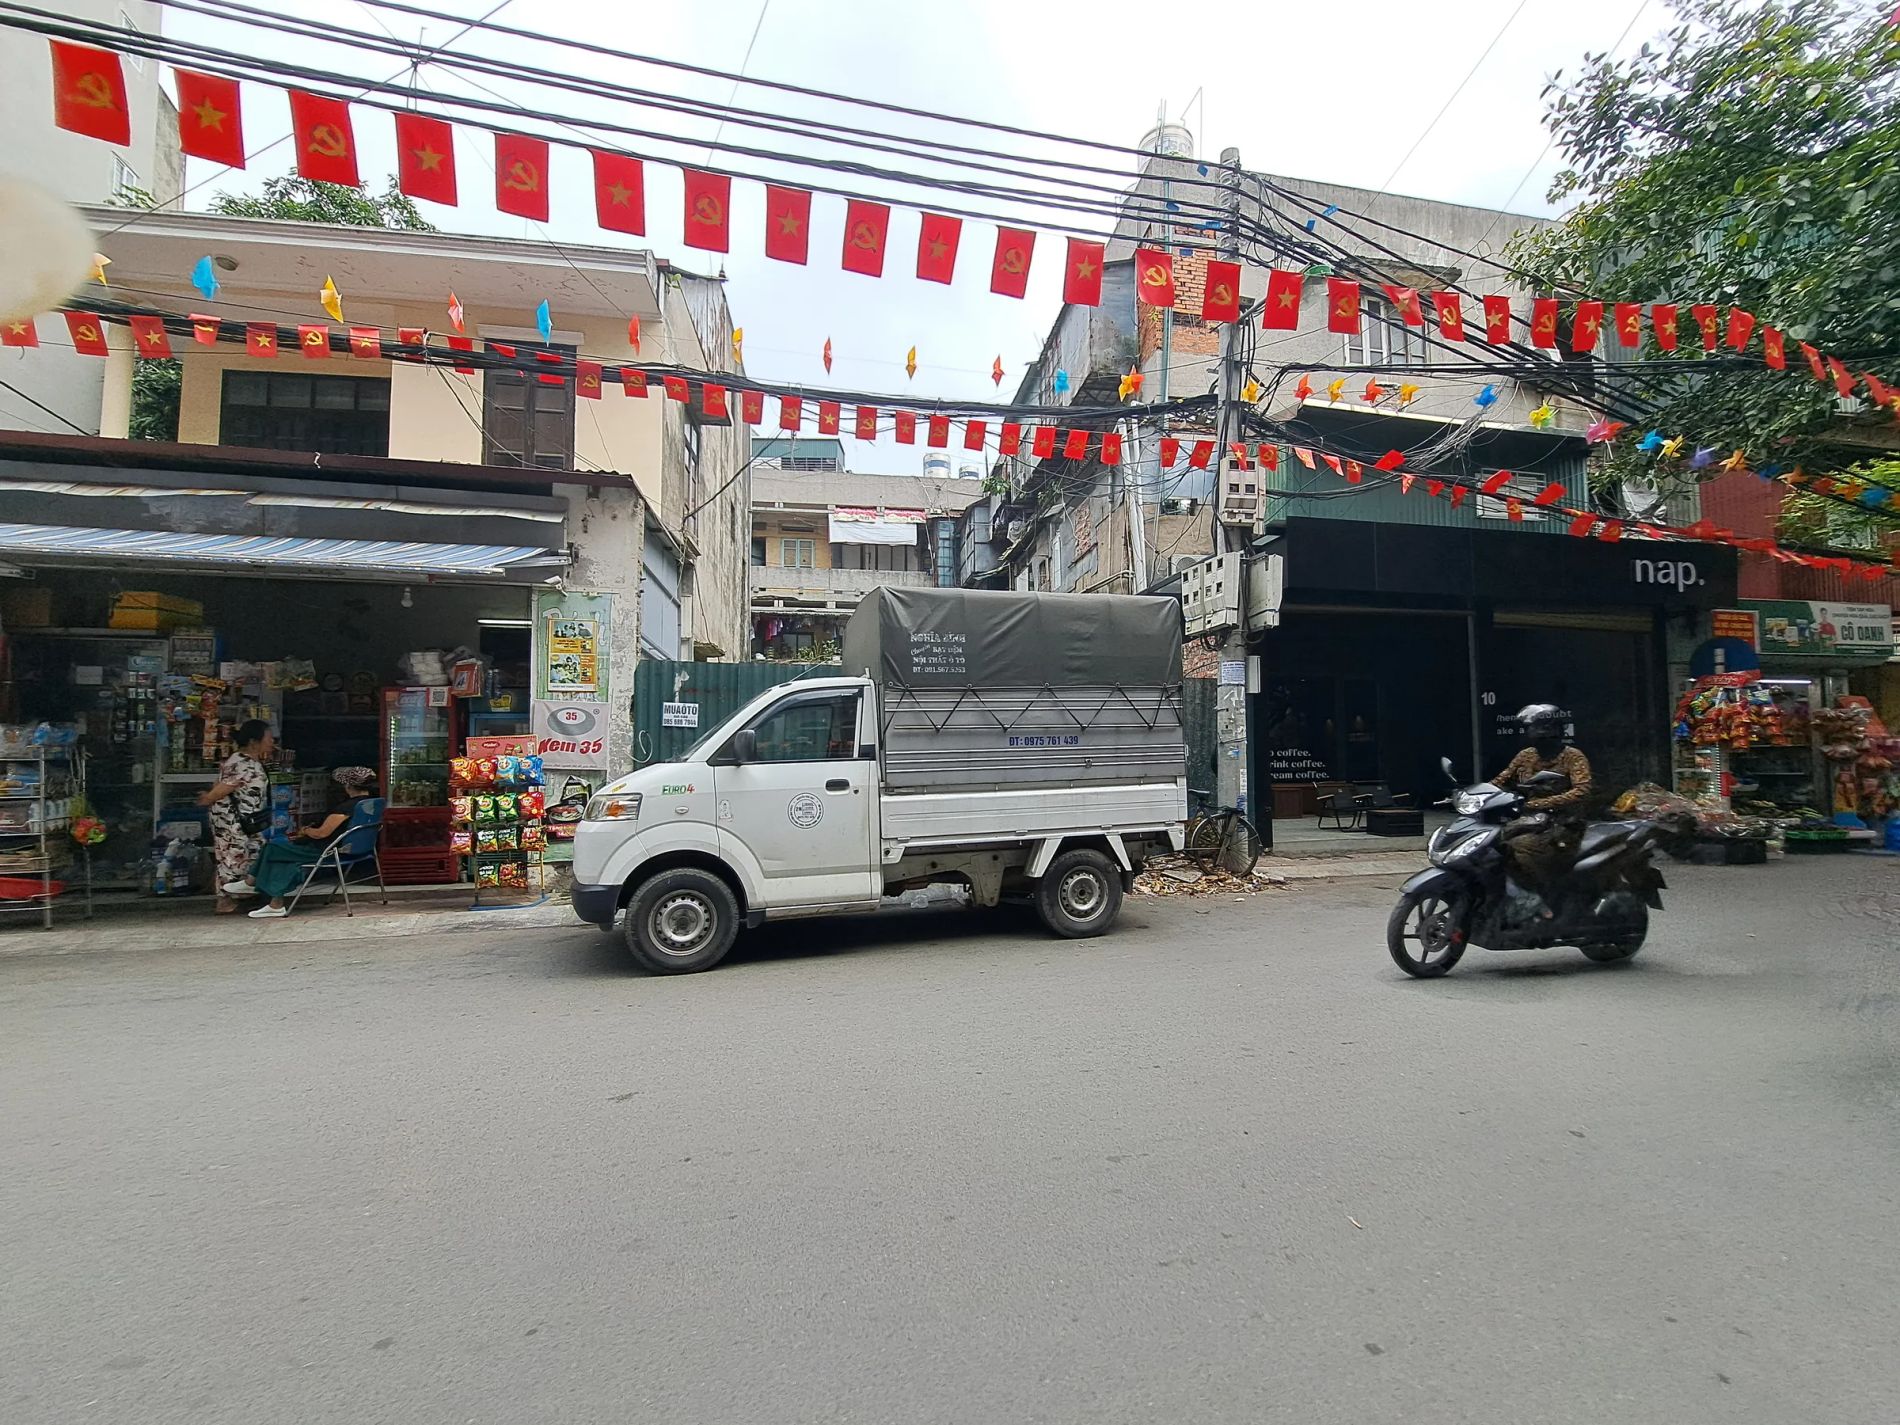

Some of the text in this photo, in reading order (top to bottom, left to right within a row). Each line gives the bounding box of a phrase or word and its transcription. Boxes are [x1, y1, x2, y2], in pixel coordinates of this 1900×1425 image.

[1635, 559, 1705, 592] nap.
[1841, 621, 1885, 641] CÔ OANH
[913, 655, 927, 665] NỘI
[928, 654, 947, 663] THẤT
[1481, 691, 1496, 705] 10
[565, 711, 578, 721] 35
[537, 736, 605, 756] Kem 35
[1009, 735, 1079, 746] ĐT: 0975 761 439
[1276, 748, 1312, 757] coffee.
[1291, 760, 1326, 768] coffee.
[1295, 770, 1330, 779] coffee.
